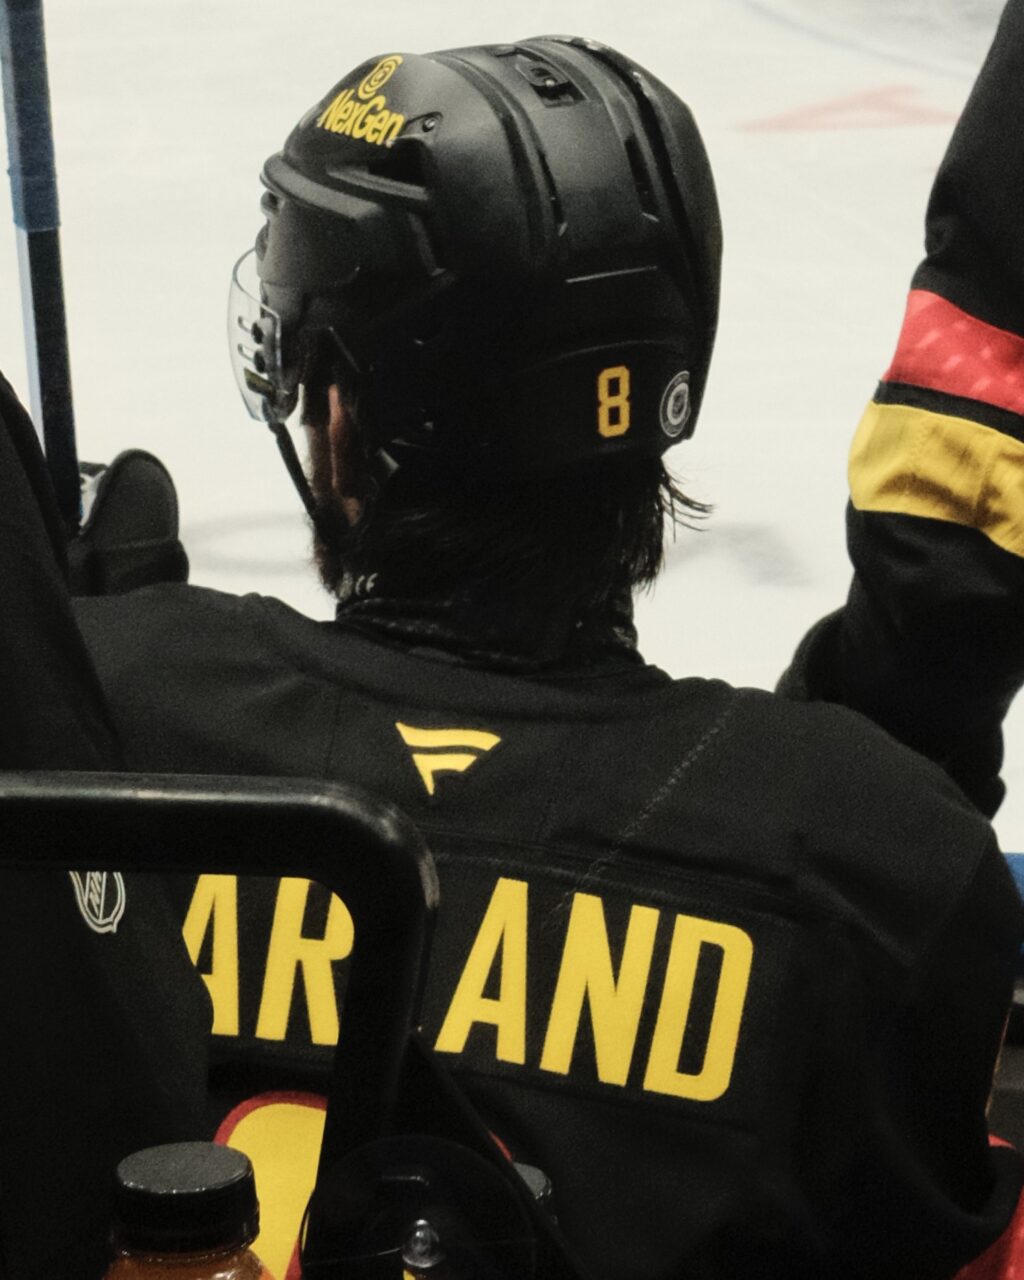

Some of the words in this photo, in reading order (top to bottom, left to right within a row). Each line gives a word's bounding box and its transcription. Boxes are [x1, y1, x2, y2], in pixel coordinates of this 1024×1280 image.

[316, 88, 405, 149] NexGen
[598, 365, 631, 439] 8
[182, 873, 754, 1102] ARAND
